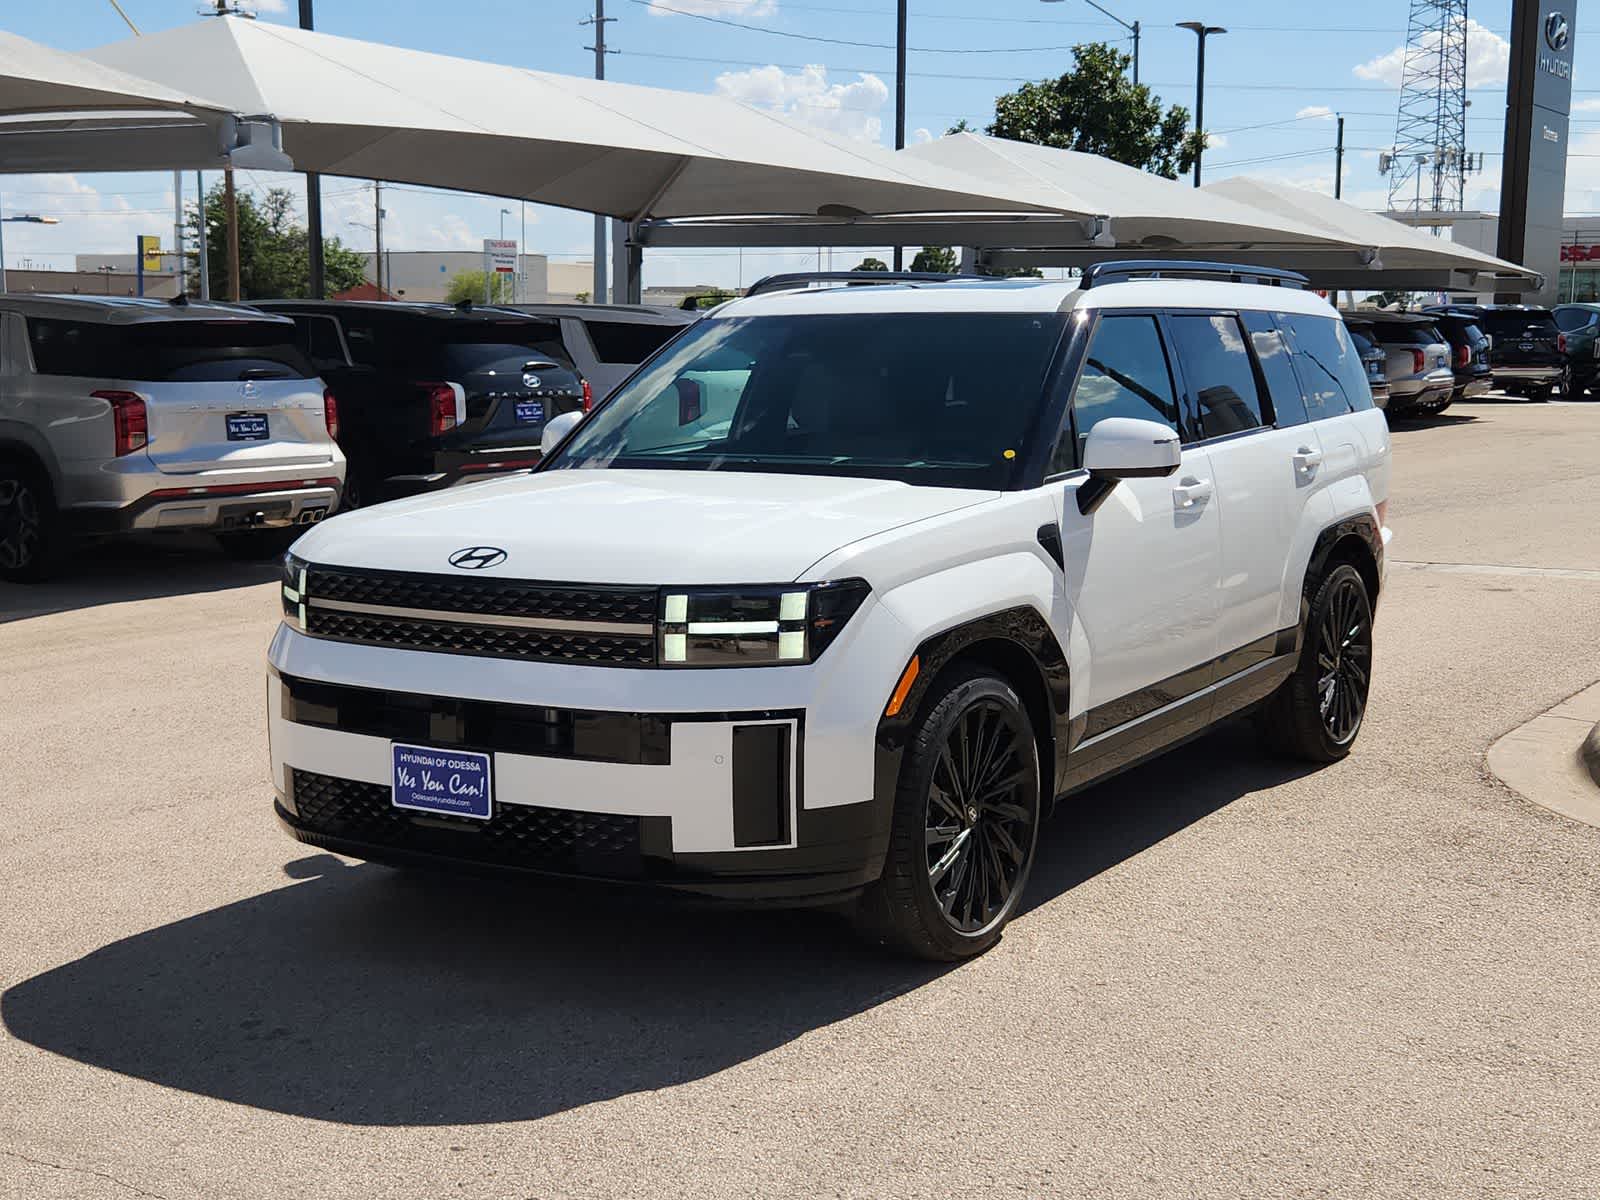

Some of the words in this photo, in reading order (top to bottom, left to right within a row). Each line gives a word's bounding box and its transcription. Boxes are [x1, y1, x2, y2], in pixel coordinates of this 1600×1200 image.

[400, 753, 435, 766] HYUNDAI
[435, 758, 446, 768] OF
[448, 760, 481, 771] ODESSA
[397, 766, 416, 788] Yes
[421, 770, 445, 791] You
[449, 774, 485, 798] Can!
